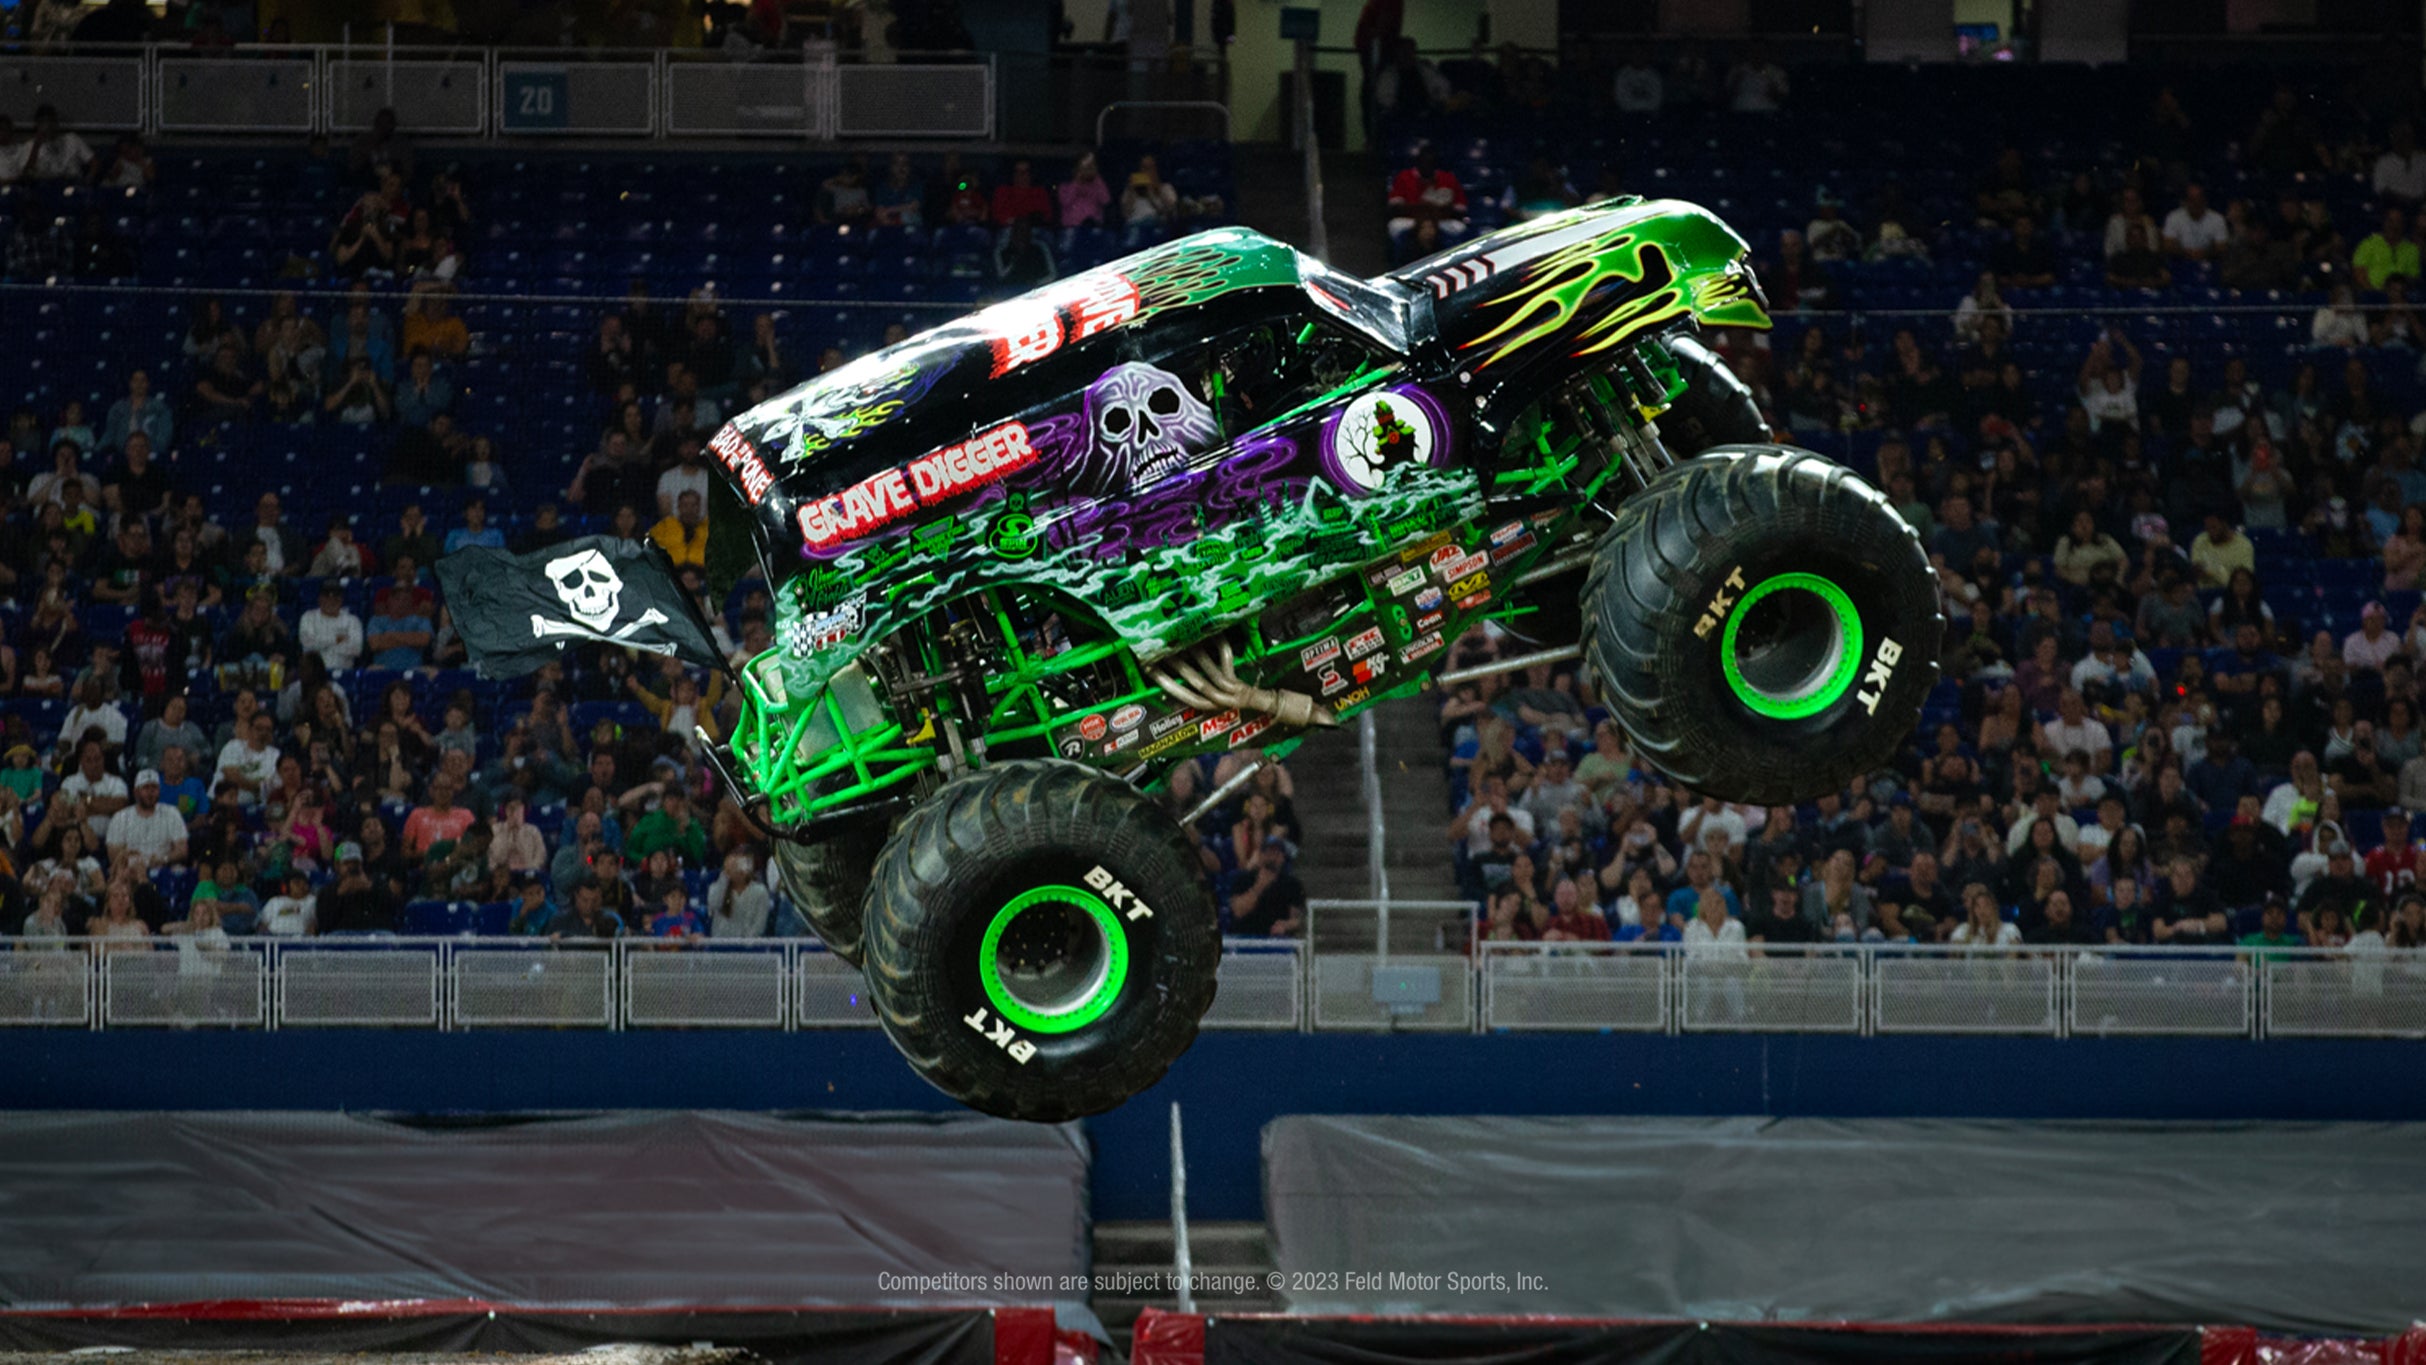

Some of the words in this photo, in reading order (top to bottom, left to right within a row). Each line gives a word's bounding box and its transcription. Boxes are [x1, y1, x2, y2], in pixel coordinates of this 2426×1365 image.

[521, 86, 553, 114] 20
[710, 424, 742, 461] BAD
[799, 471, 914, 542] GRAVE
[911, 423, 1033, 498] DIGGER
[1392, 569, 1421, 591] BKT
[1447, 553, 1485, 579] SIMPSON
[1692, 565, 1746, 641] BKT
[1302, 638, 1337, 661] OPTIMA
[1857, 636, 1903, 716] BKT
[1334, 685, 1371, 711] UNOH
[1151, 714, 1184, 735] Holley
[1202, 708, 1239, 735] MSD
[1140, 725, 1196, 757] MAGNAFLOW
[1083, 865, 1154, 922] BKT
[963, 1007, 1037, 1065] BKT
